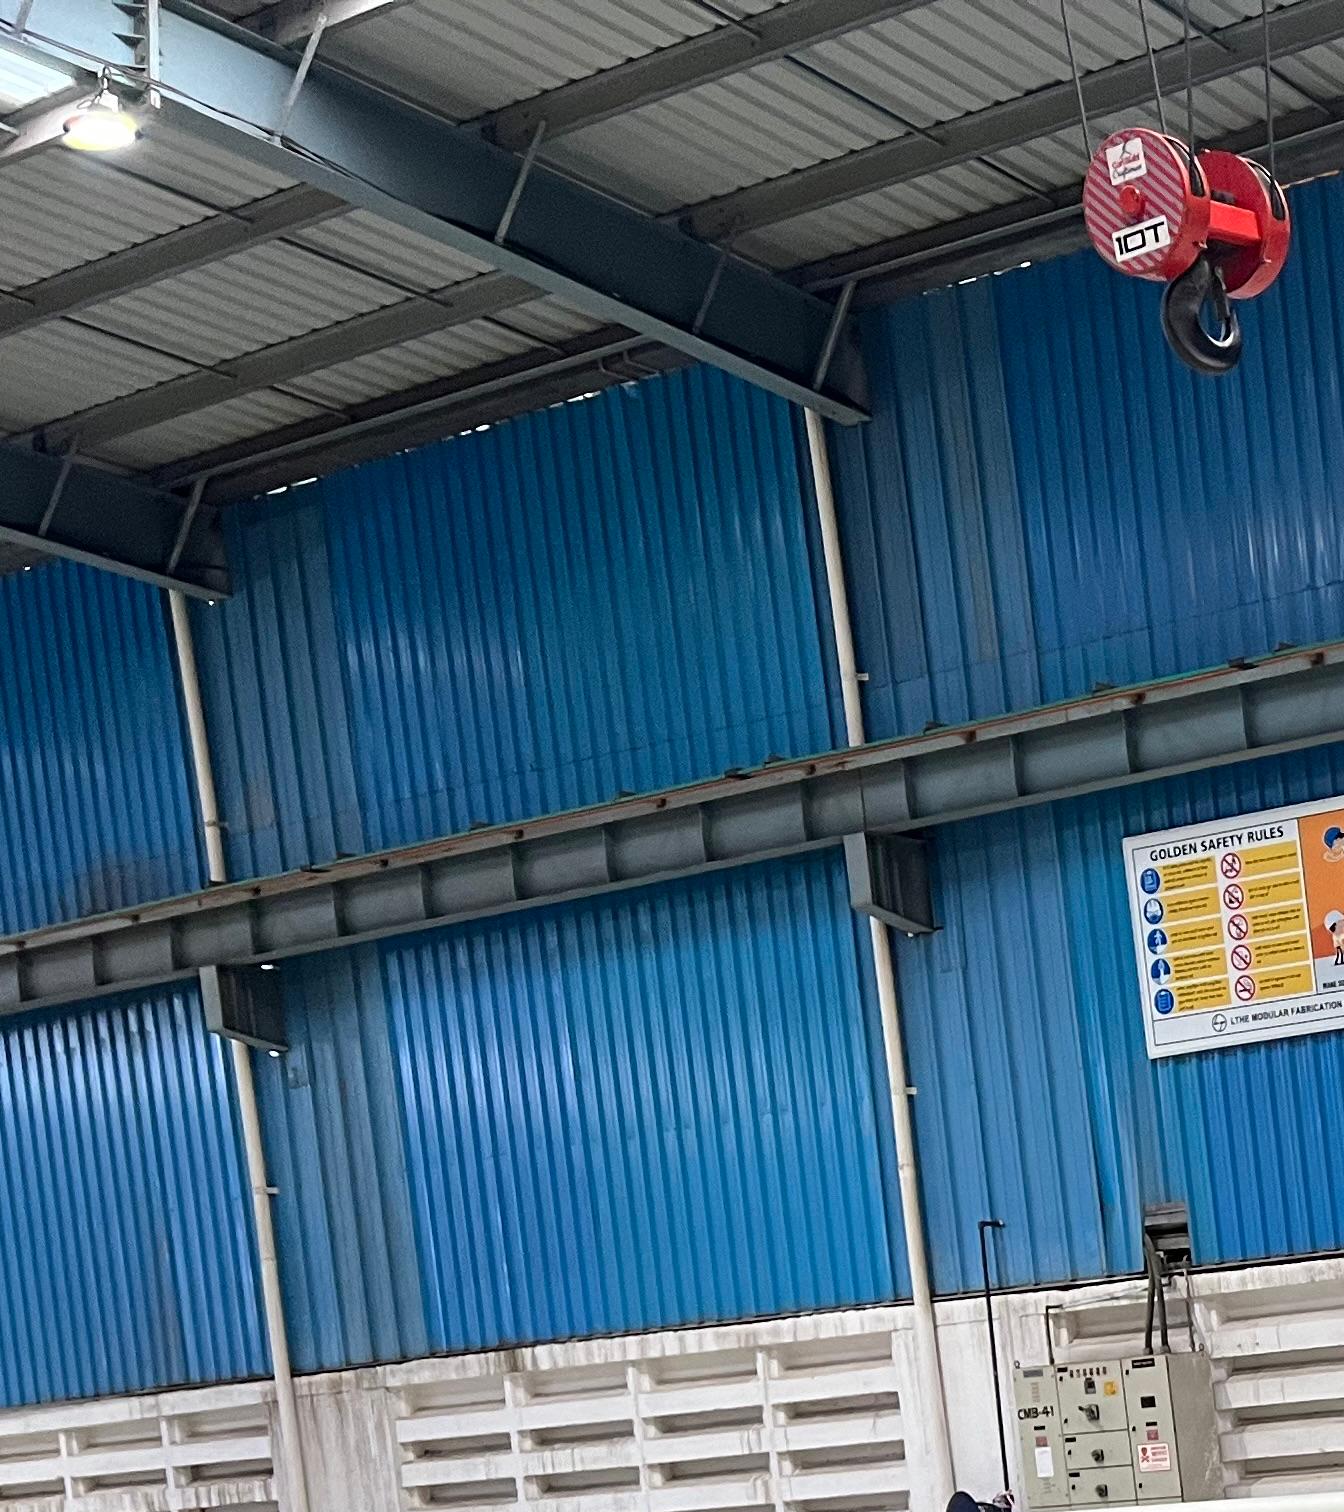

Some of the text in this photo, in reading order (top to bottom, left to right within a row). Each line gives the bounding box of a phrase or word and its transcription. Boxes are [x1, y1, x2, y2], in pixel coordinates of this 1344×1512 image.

[1150, 825, 1284, 861] GOLDEN SAFETY RULES
[1251, 1009, 1289, 1022] MODULAR
[1291, 1001, 1343, 1017] FABRICATION
